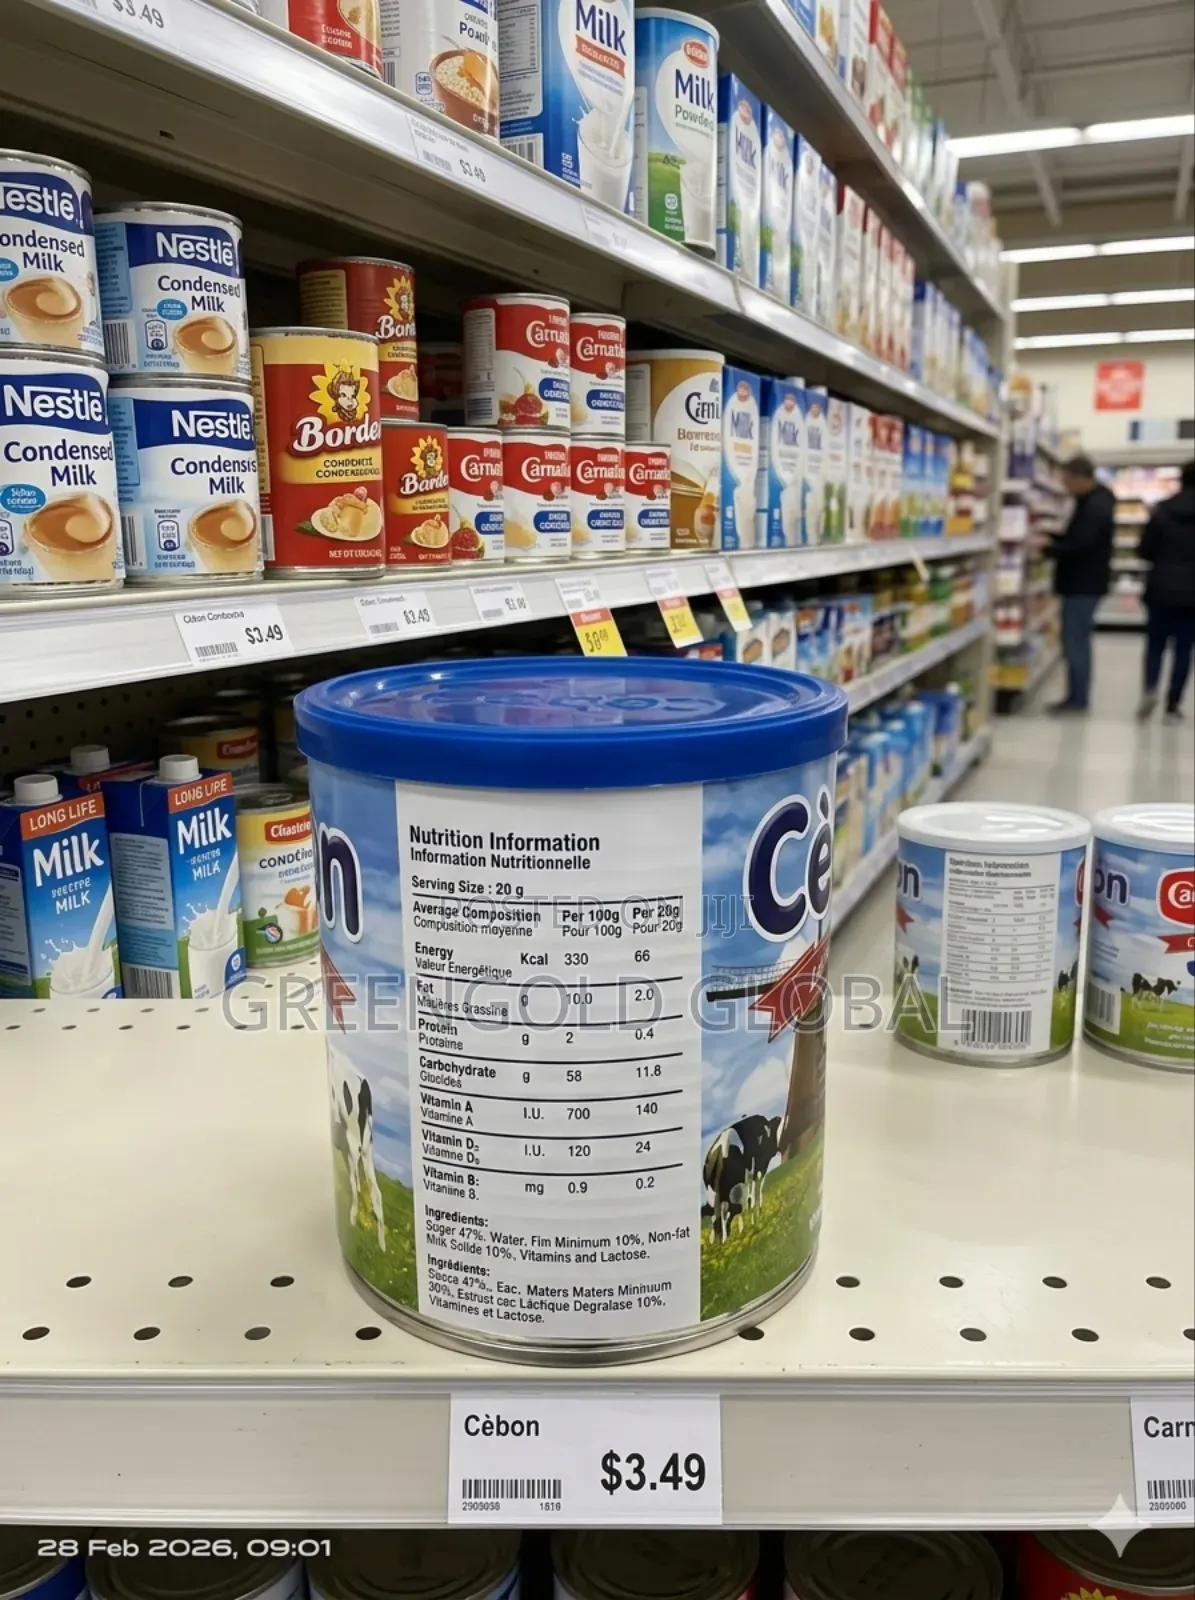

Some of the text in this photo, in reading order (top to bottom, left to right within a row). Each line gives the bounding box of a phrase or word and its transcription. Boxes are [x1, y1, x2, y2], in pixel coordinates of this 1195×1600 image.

[575, 0, 628, 57] Milk
[674, 69, 715, 114] Milk
[0, 230, 85, 258] ondensed
[23, 252, 65, 274] Milk
[191, 296, 226, 313] Milk
[293, 413, 381, 452] Borde
[50, 464, 98, 487] Milk
[208, 477, 246, 495] Milk
[244, 623, 284, 645] $3.49
[29, 799, 98, 832] LONG LIFE
[176, 807, 233, 855] Milk
[409, 824, 600, 852] Nutrition Information
[32, 831, 105, 888] Milk
[410, 847, 591, 870] Information Nutritionnelle
[411, 875, 456, 895] Serving
[458, 879, 485, 894] Size
[495, 882, 513, 896] 20
[515, 885, 525, 899] g
[54, 891, 91, 915] MILK
[413, 900, 460, 919] Average
[562, 910, 585, 922] Per
[588, 909, 620, 924] 100g
[632, 906, 655, 919] Per
[562, 925, 589, 937] Pour
[594, 924, 622, 939] 100g
[632, 921, 660, 934] Pour
[661, 919, 684, 933] 20g
[415, 941, 650, 966] Energy Kcal 330 66
[415, 957, 446, 973] Valeur
[416, 980, 435, 994] Fat
[634, 988, 655, 1002] 2.0
[418, 1018, 655, 1046] Protein g 2 0.4
[522, 1071, 531, 1084] g
[566, 1070, 583, 1082] 58
[635, 1065, 662, 1079] 11.8
[464, 1100, 474, 1113] A
[523, 1106, 545, 1120] I.U.
[566, 1108, 591, 1121] 700
[635, 1102, 659, 1115] 140
[464, 1115, 474, 1127] A
[524, 1144, 546, 1157] I.U.
[568, 1145, 592, 1158] 120
[635, 1141, 652, 1154] 24
[423, 1164, 464, 1184] Vitamin
[524, 1183, 545, 1196] mg
[567, 1181, 588, 1195] 0.9
[635, 1176, 655, 1190] 0.2
[424, 1204, 489, 1228] Ingredients:
[554, 1236, 612, 1249] Minimum
[648, 1226, 691, 1244] Non-fat
[519, 1248, 572, 1264] Vitamins
[574, 1251, 597, 1264] and
[600, 1249, 651, 1263] Lactose.
[457, 1288, 494, 1305] Estrust
[573, 1299, 634, 1315] Degralase
[526, 1284, 570, 1298] Maters
[572, 1285, 615, 1298] Maters
[428, 1294, 545, 1324] Vitamines et Lactose.
[463, 1413, 541, 1438] Cèbon
[600, 1449, 707, 1496] $3.49
